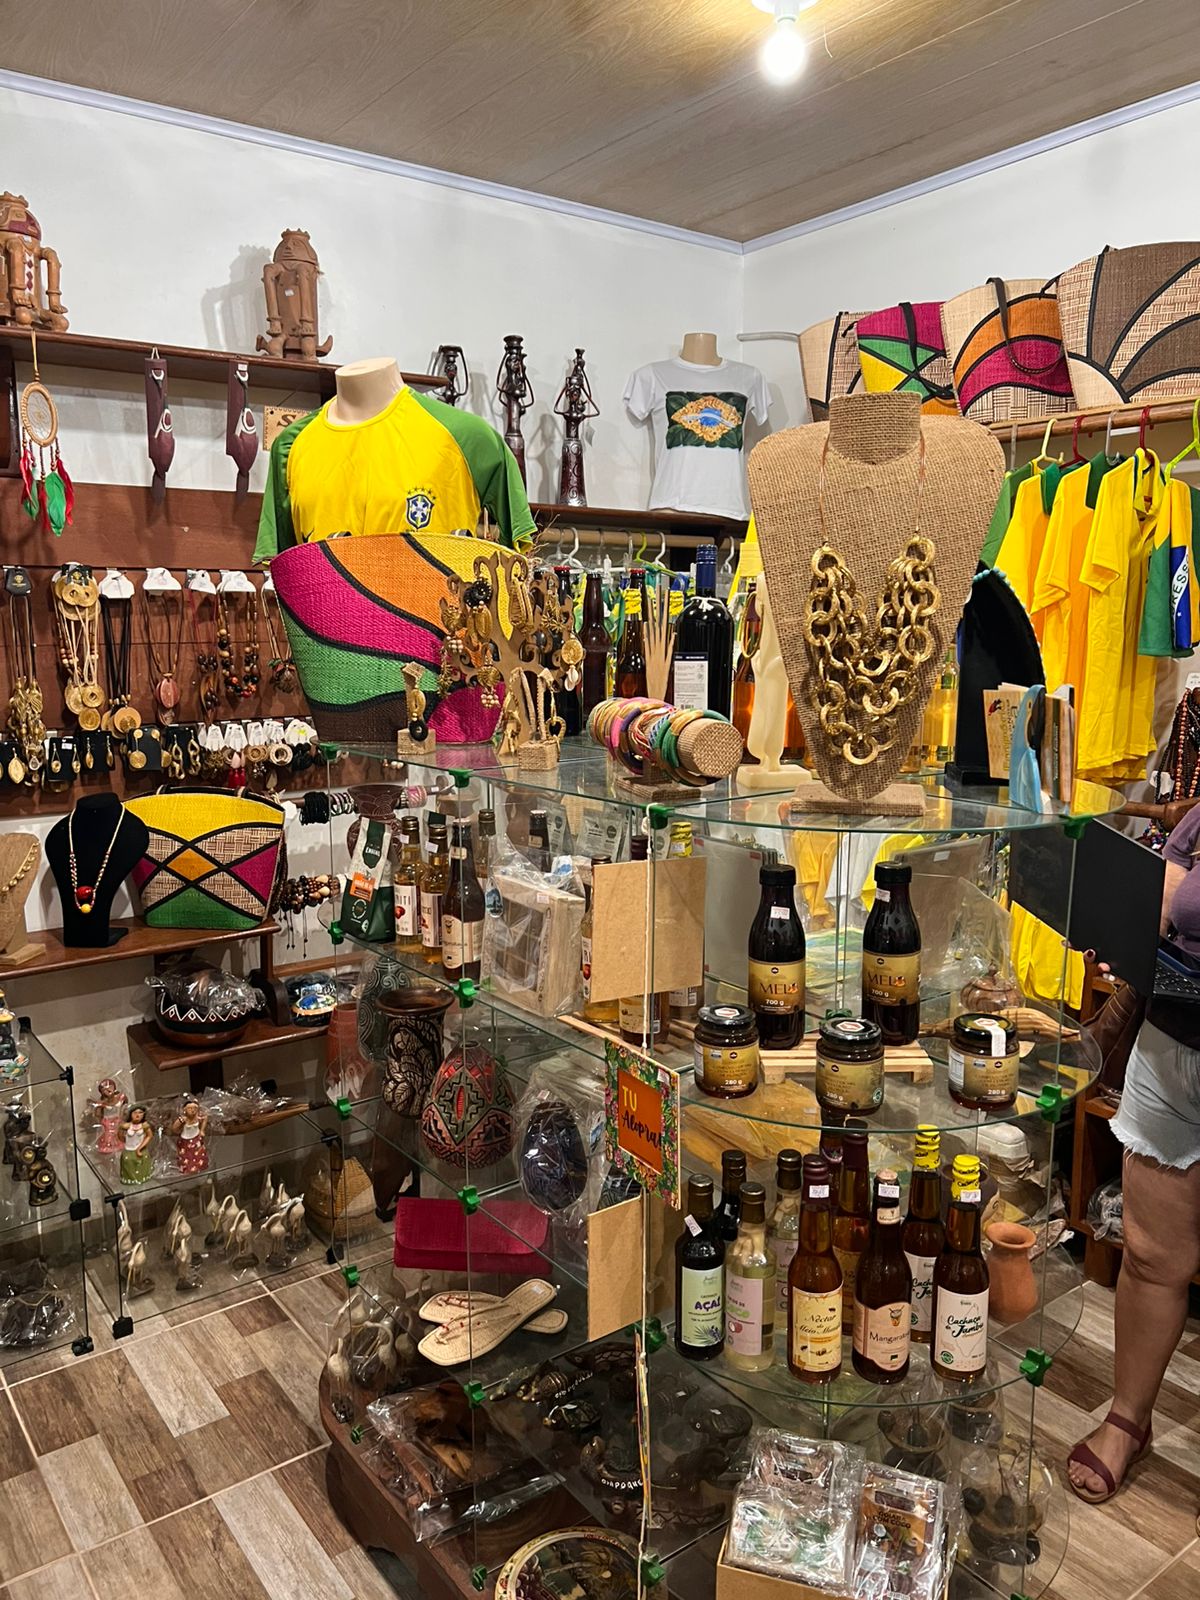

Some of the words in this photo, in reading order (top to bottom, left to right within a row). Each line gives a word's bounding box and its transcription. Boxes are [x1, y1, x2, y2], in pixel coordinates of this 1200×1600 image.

[868, 971, 896, 987] MEL
[759, 983, 788, 995] MEL
[871, 988, 883, 996] 700
[622, 1085, 637, 1112] TU
[695, 1296, 721, 1312] AÇAÍ
[947, 1315, 981, 1325] Cachaça
[952, 1322, 983, 1338] Jambu
